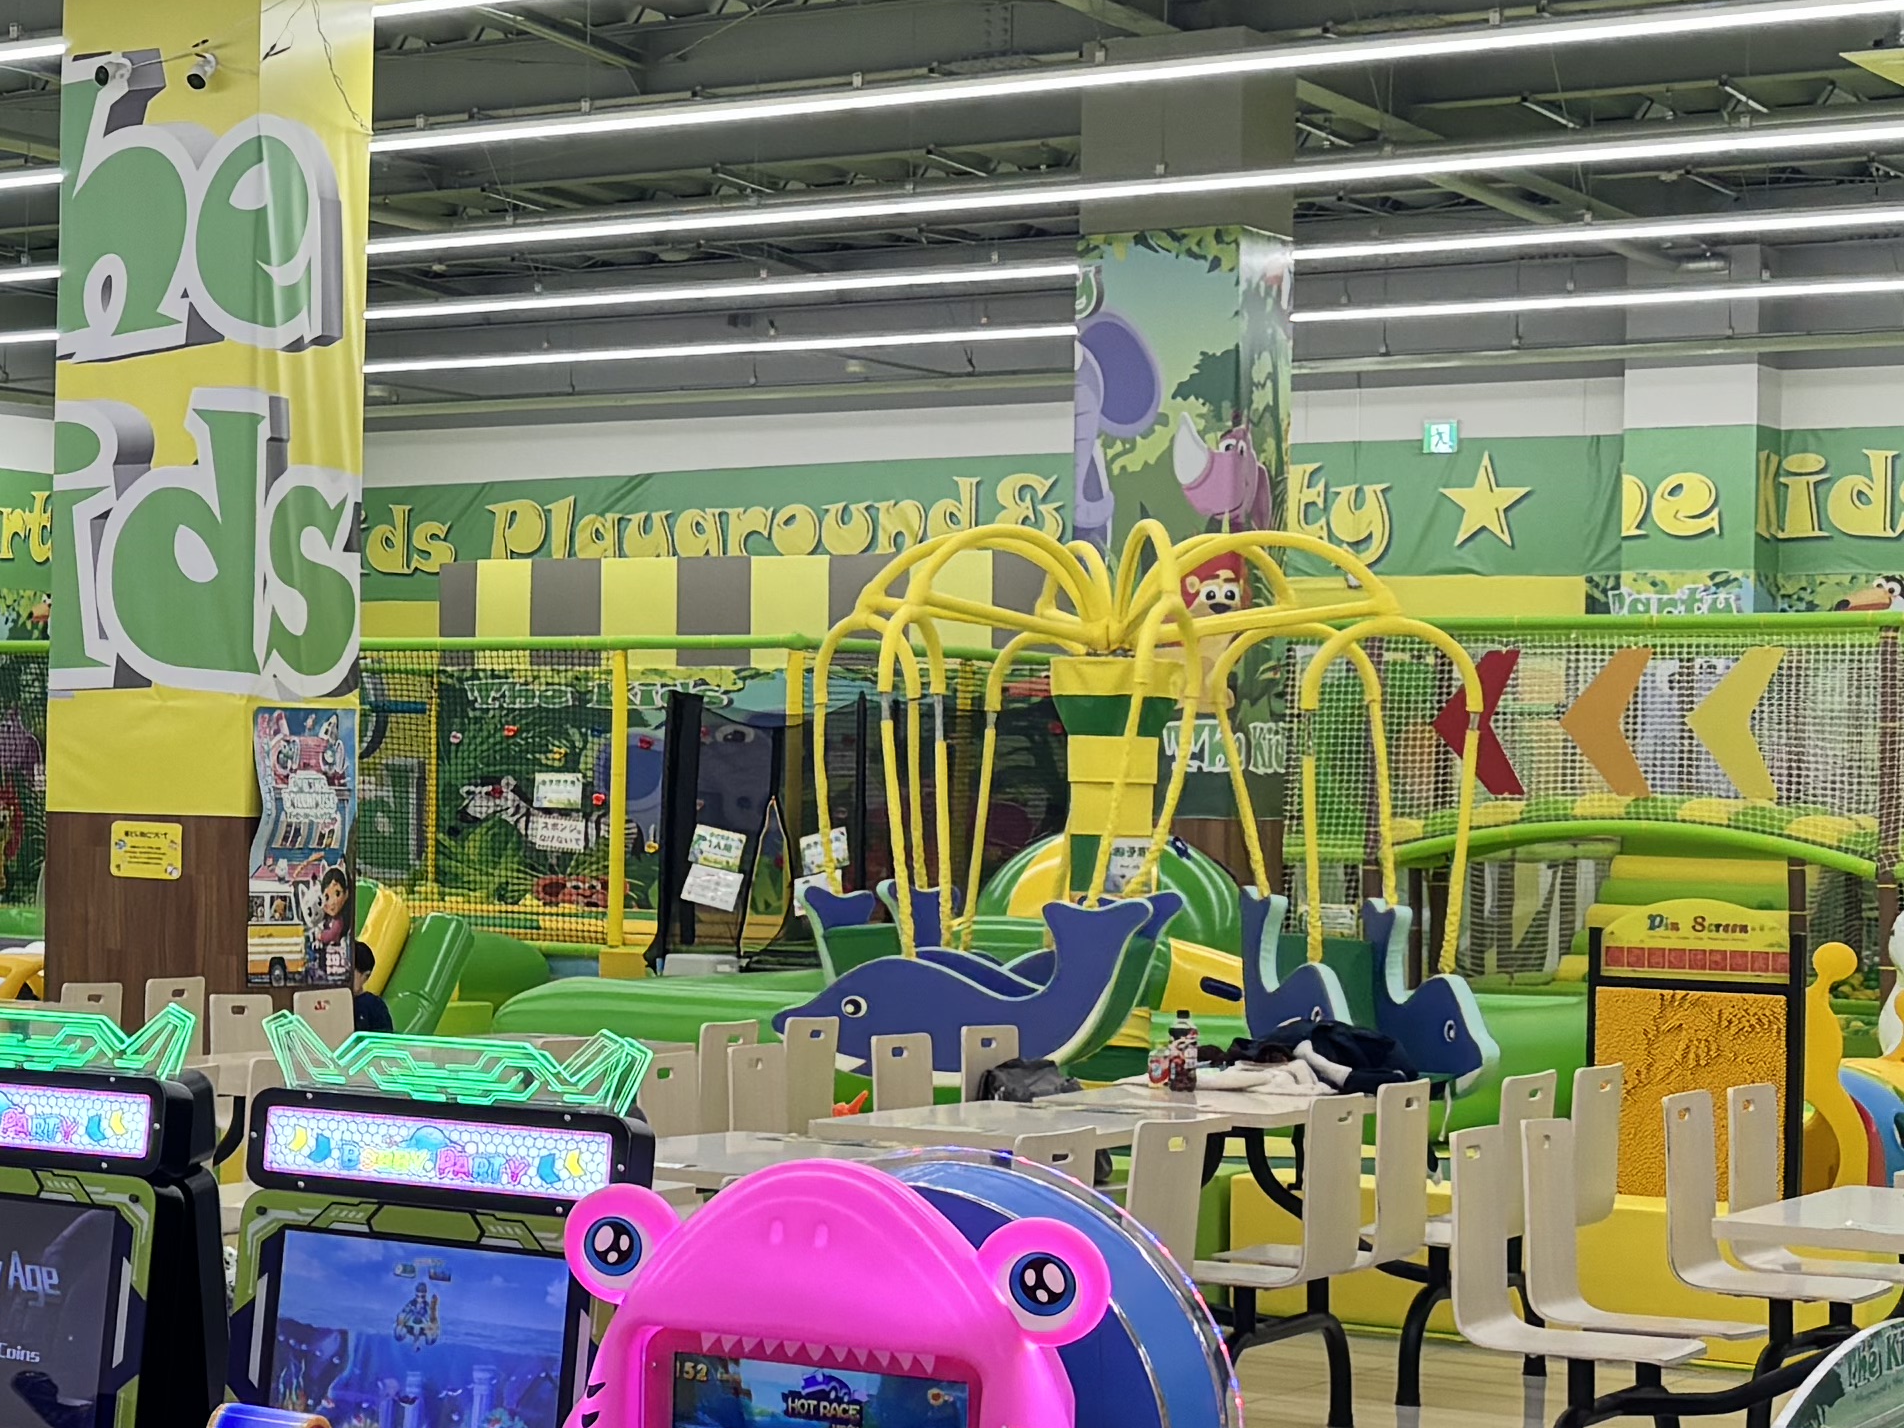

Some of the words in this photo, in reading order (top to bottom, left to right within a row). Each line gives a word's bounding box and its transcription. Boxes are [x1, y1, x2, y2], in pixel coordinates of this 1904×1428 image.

[56, 62, 340, 362] he
[1756, 448, 1904, 542] Kid
[49, 386, 360, 695] ids
[1647, 914, 1680, 933] Pin
[1691, 915, 1750, 935] Screen
[436, 1146, 531, 1184] PARTY
[8, 1250, 61, 1309] Age
[788, 1397, 818, 1416] HOT
[819, 1400, 861, 1421] RACE
